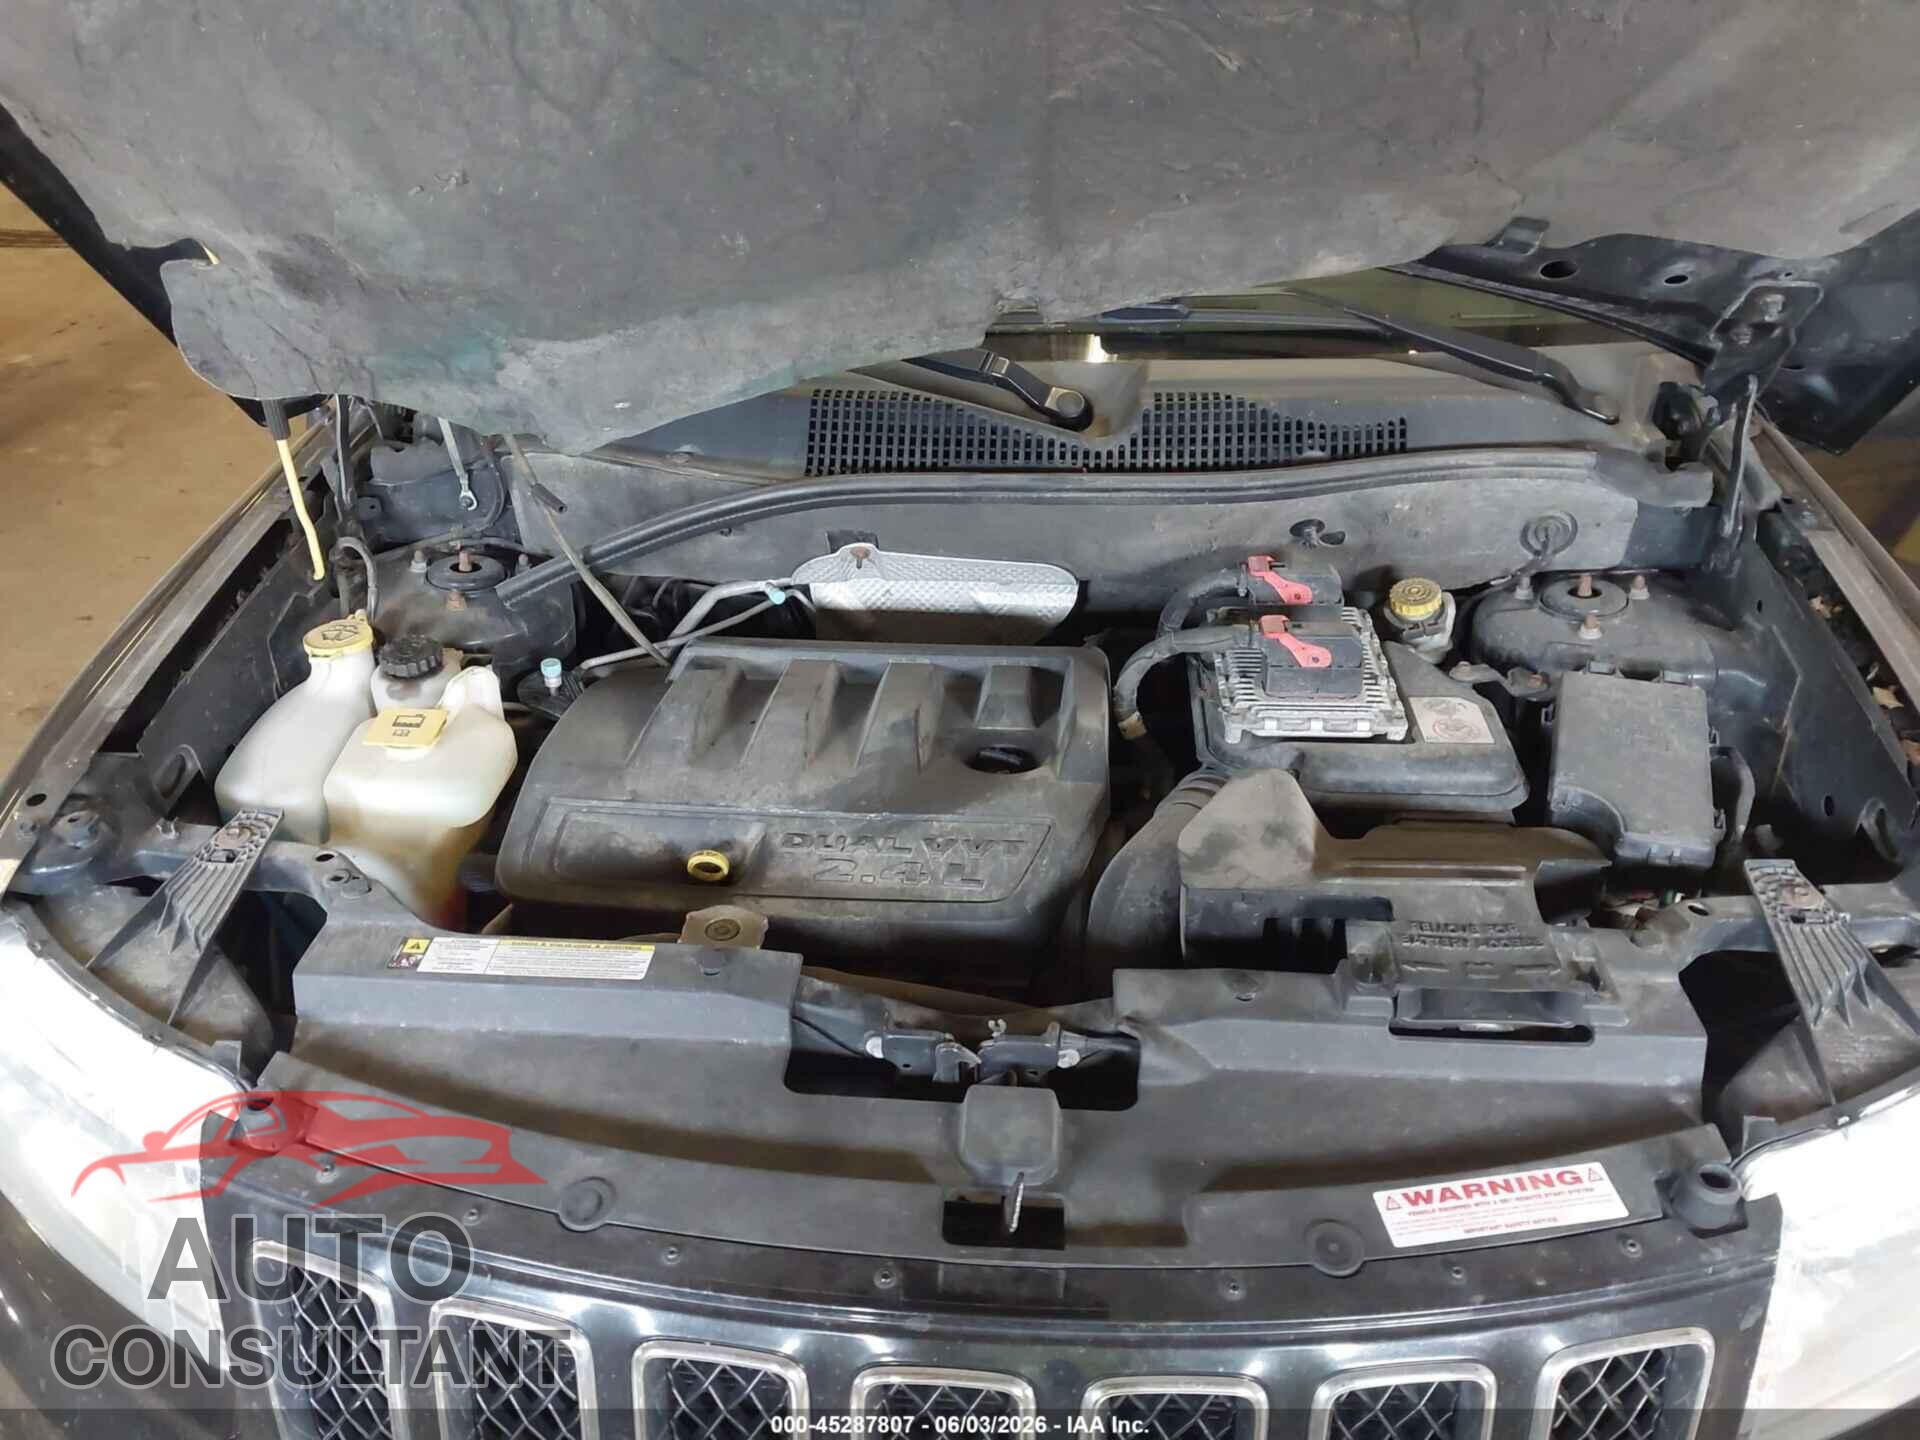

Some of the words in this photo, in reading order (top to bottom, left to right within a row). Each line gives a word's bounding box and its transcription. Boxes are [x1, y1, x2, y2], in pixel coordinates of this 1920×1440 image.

[781, 831, 913, 856] DUAL
[921, 836, 1027, 857] VVT
[813, 857, 986, 890] 2.4L
[1401, 1170, 1584, 1207] WARNING
